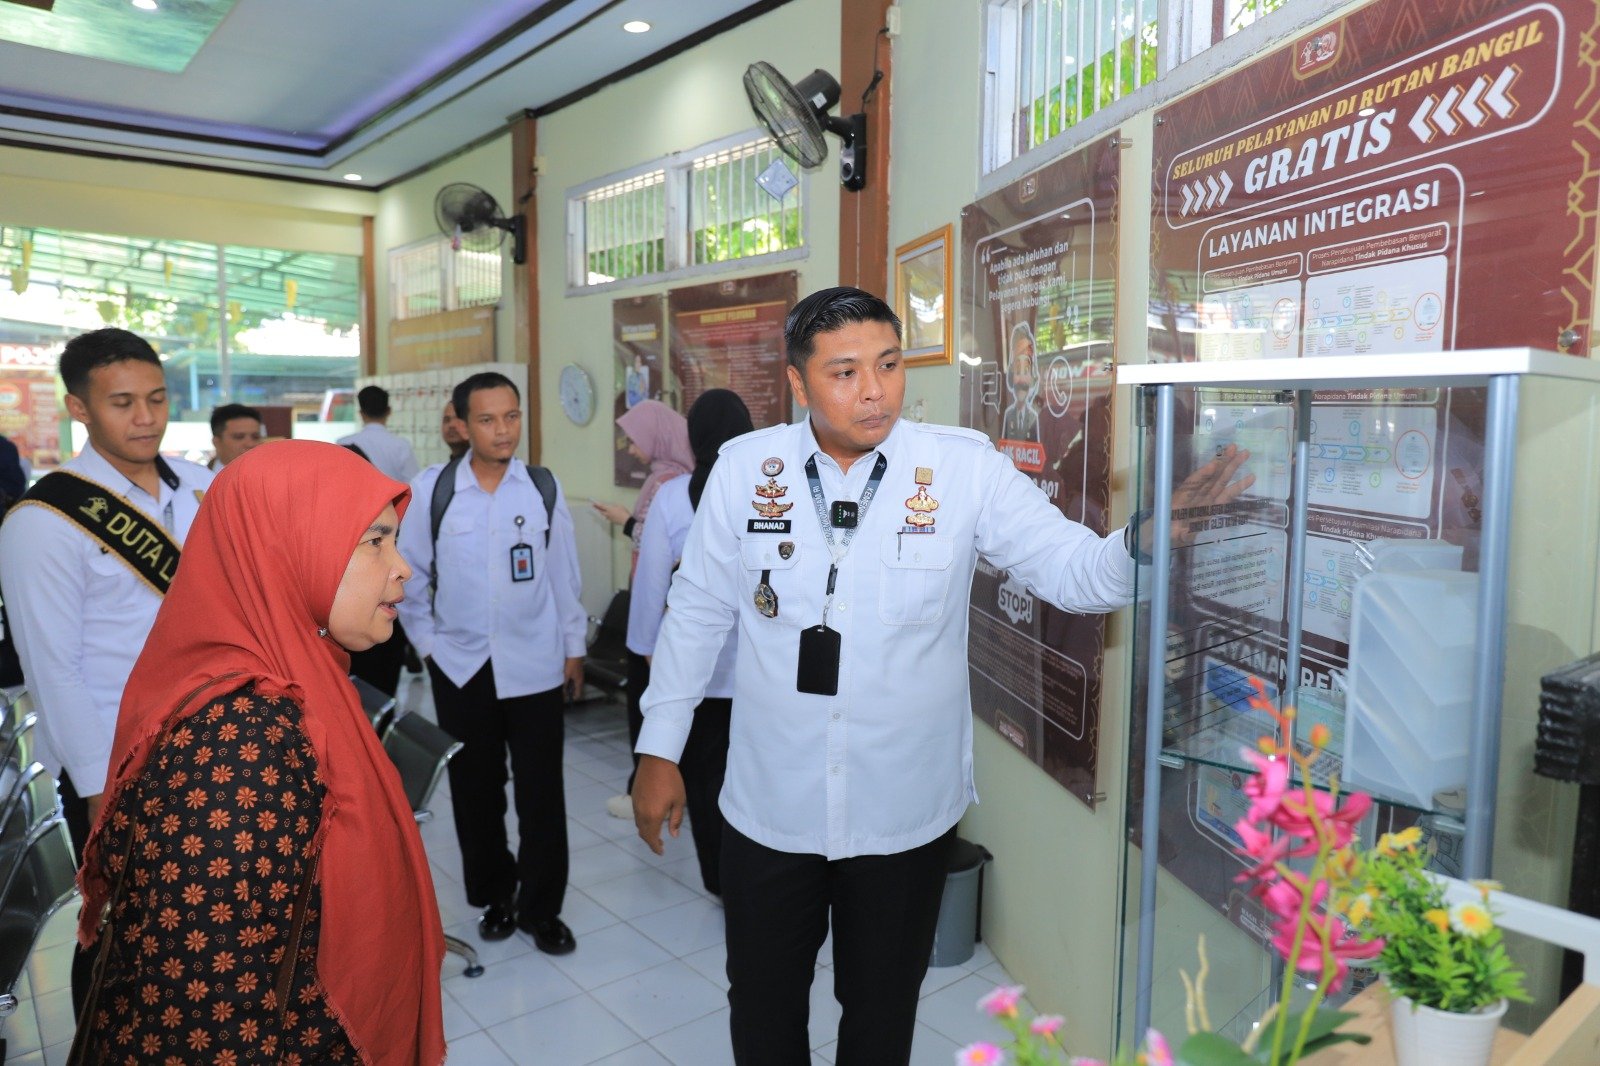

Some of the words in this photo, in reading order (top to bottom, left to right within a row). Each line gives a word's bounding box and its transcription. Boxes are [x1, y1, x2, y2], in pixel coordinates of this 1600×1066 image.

[1172, 145, 1233, 181] SELURUH
[1235, 105, 1332, 157] PELAYANAN
[1334, 94, 1358, 120] DI
[1358, 62, 1438, 111] RUTAN
[1440, 19, 1544, 79] BANGIL
[1244, 108, 1397, 195] GRATIS
[1209, 217, 1298, 259] LAYANAN
[1304, 181, 1440, 236] INTEGRASI
[1012, 254, 1025, 267] ada
[1025, 246, 1053, 263] keluhan
[1054, 241, 1069, 254] dan
[1331, 245, 1365, 259] Persetujuan
[1366, 237, 1408, 250] Pembebasan
[1409, 229, 1442, 242] Bersyarat
[1355, 252, 1376, 261] Tindak
[1377, 248, 1400, 257] Pidana
[1402, 242, 1428, 252] Khusus
[1014, 269, 1030, 283] puas
[1030, 261, 1057, 277] dengan
[1019, 279, 1046, 294] Petugas
[1001, 301, 1021, 315] segera
[1347, 392, 1367, 400] Tindak
[753, 521, 785, 531] BHANAD
[1315, 514, 1351, 527] Persetujuan
[1381, 525, 1422, 539] Narapidana
[1320, 524, 1341, 535] Tindak
[1342, 528, 1365, 538] Pidana
[106, 511, 159, 569] DUTA
[1000, 587, 1031, 619] STOP!
